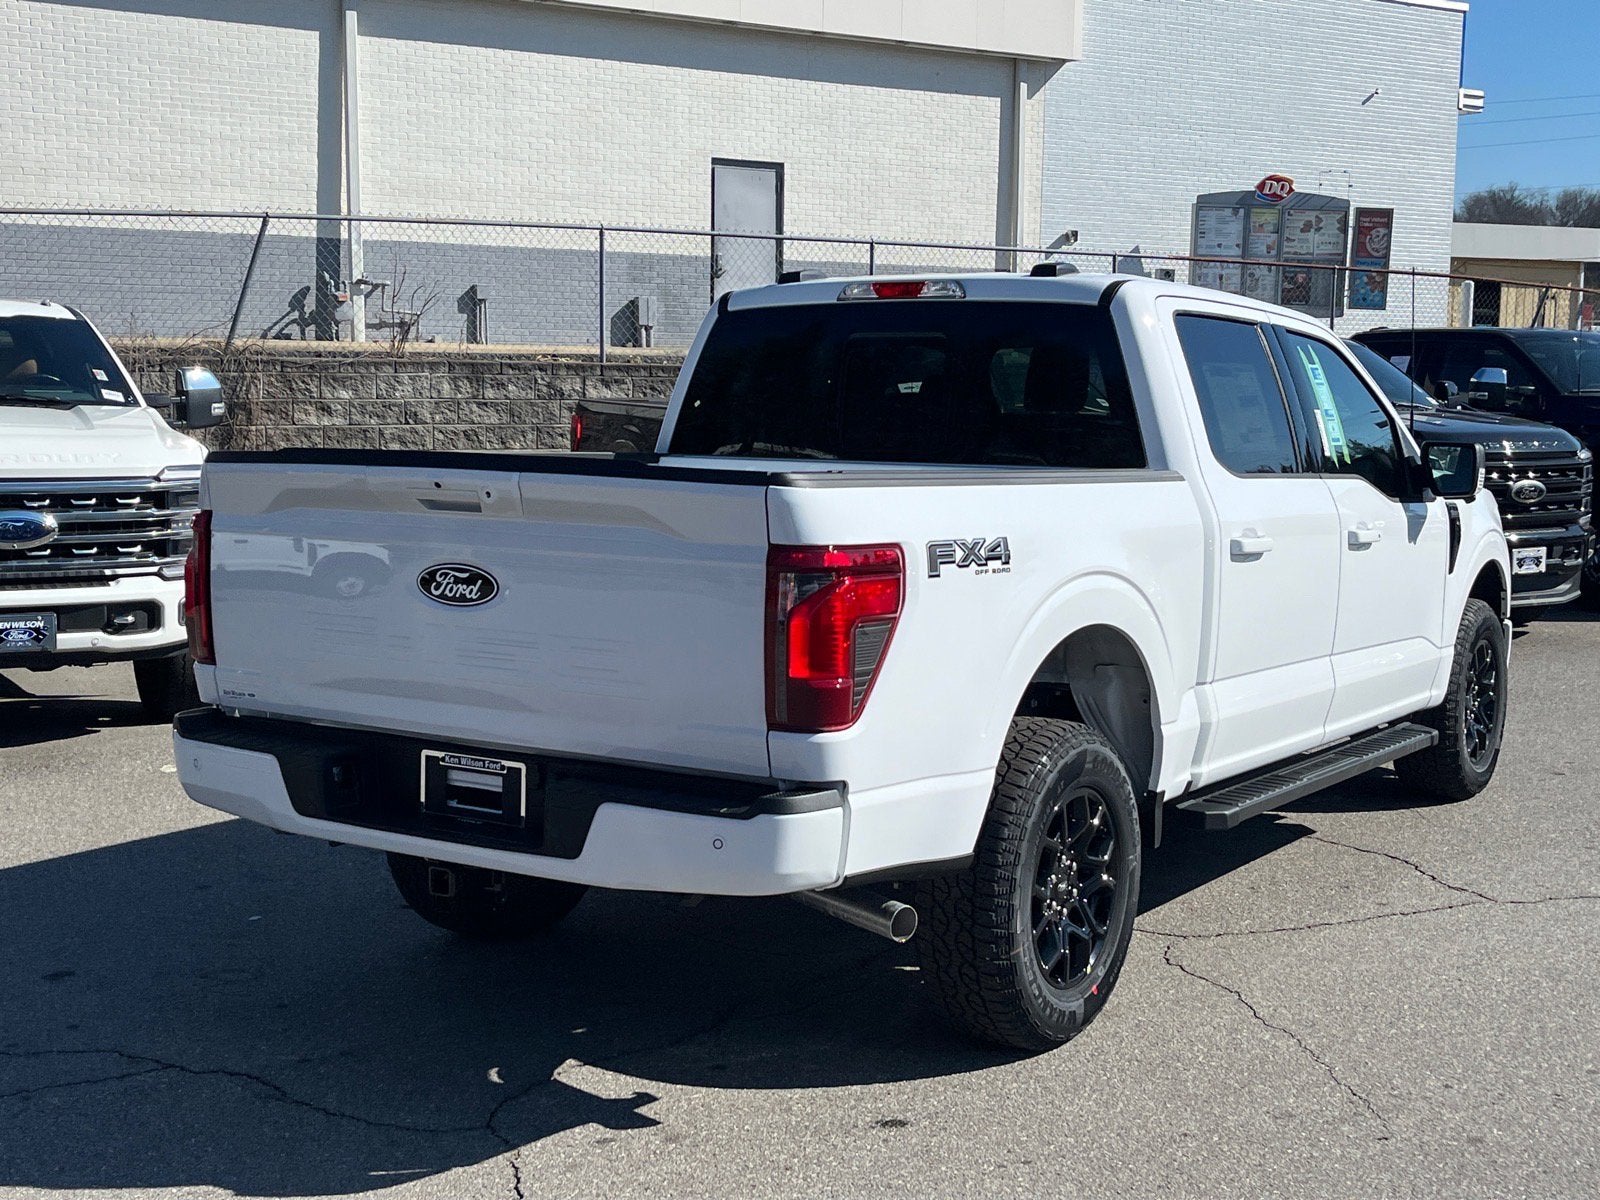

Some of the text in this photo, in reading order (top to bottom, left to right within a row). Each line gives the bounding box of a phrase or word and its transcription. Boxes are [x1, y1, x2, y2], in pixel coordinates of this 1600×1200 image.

[1262, 180, 1290, 197] DQ
[926, 536, 1011, 579] FX4
[431, 569, 483, 600] Ford
[0, 620, 45, 629] EN WILSON
[8, 630, 29, 640] Ford
[445, 755, 501, 770] Ken Wilson Ford
